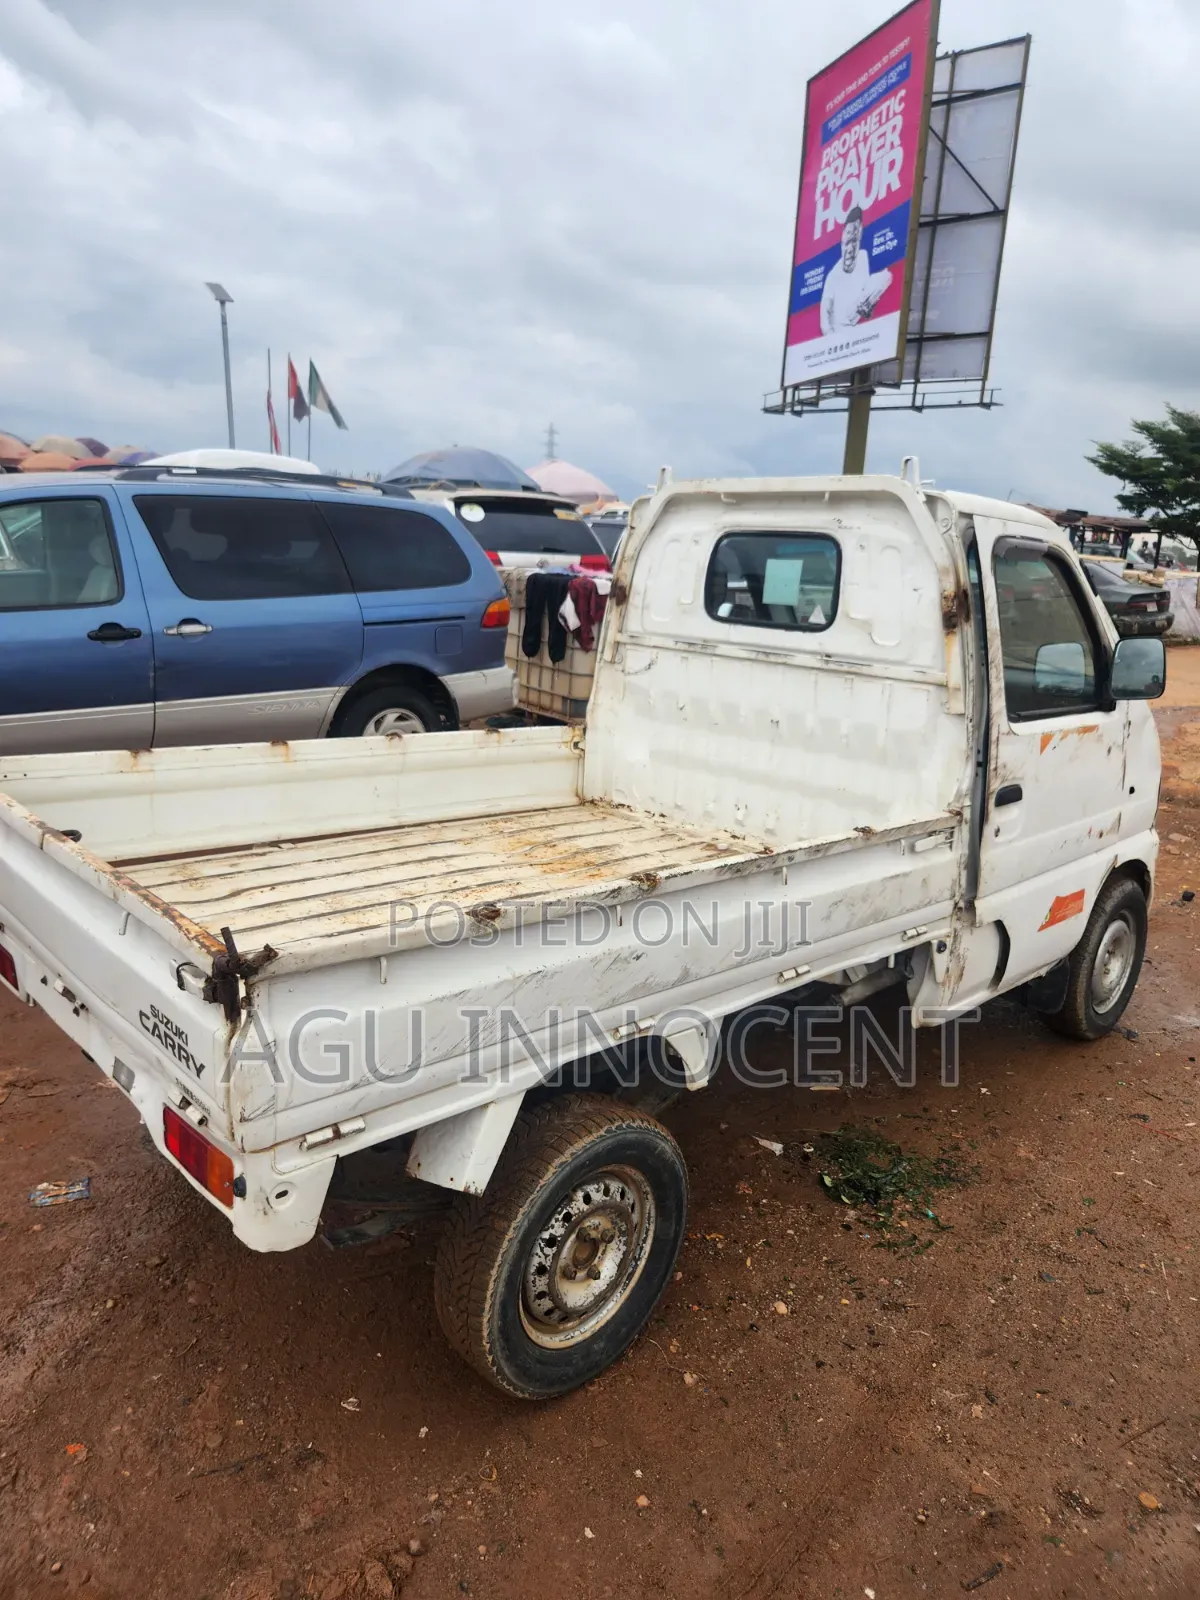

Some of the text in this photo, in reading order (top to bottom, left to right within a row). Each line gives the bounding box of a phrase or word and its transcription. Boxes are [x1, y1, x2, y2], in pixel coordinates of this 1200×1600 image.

[815, 115, 903, 202] PRAYER
[821, 88, 907, 169] PROPHETIC
[813, 146, 904, 241] HOUR
[804, 266, 825, 279] MONDAY
[885, 239, 898, 250] Oye
[139, 1010, 206, 1079] CARRY
[150, 1004, 189, 1047] SUZUKI
